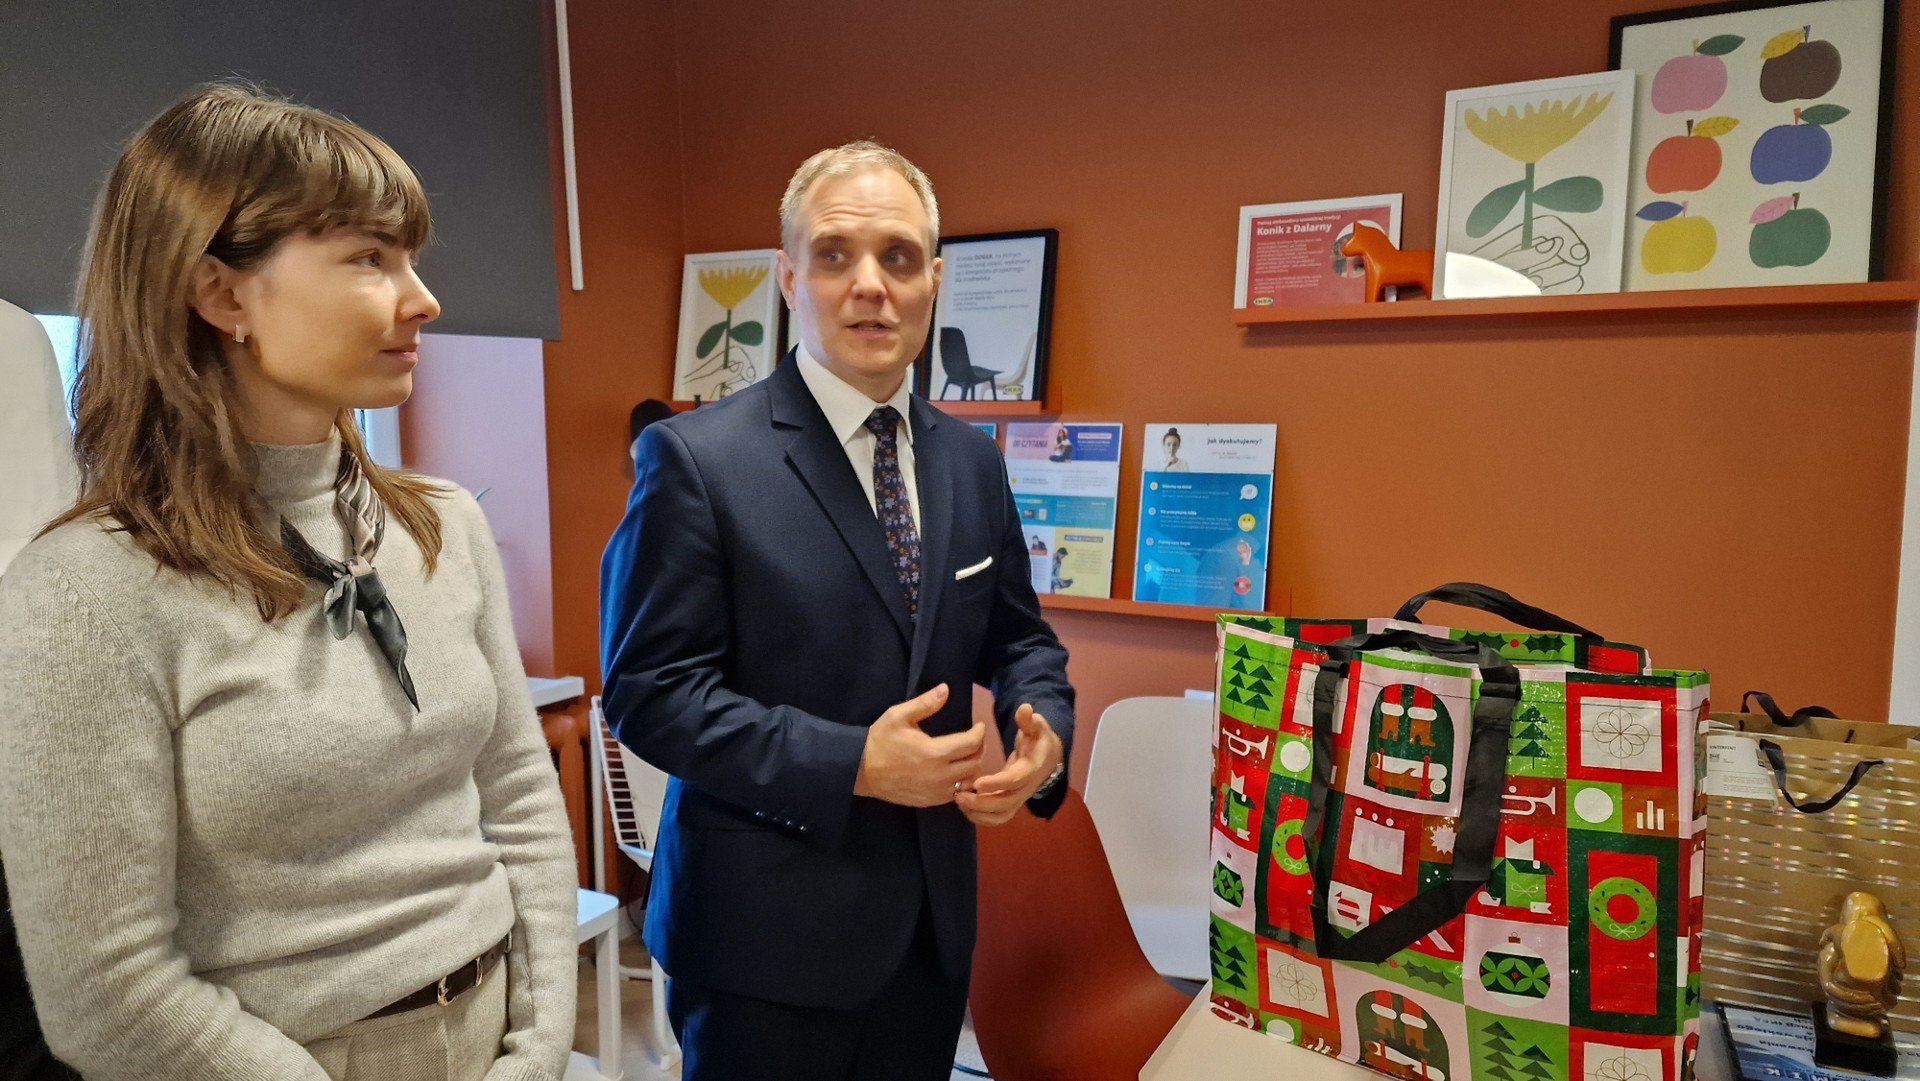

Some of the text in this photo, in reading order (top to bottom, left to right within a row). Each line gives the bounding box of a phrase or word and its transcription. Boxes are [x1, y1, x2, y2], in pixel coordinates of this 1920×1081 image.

[1256, 223, 1332, 236] Konik z Dalarny
[1021, 439, 1048, 448] CZYTANIA
[1207, 438, 1263, 446] Jak dyskutujemy?
